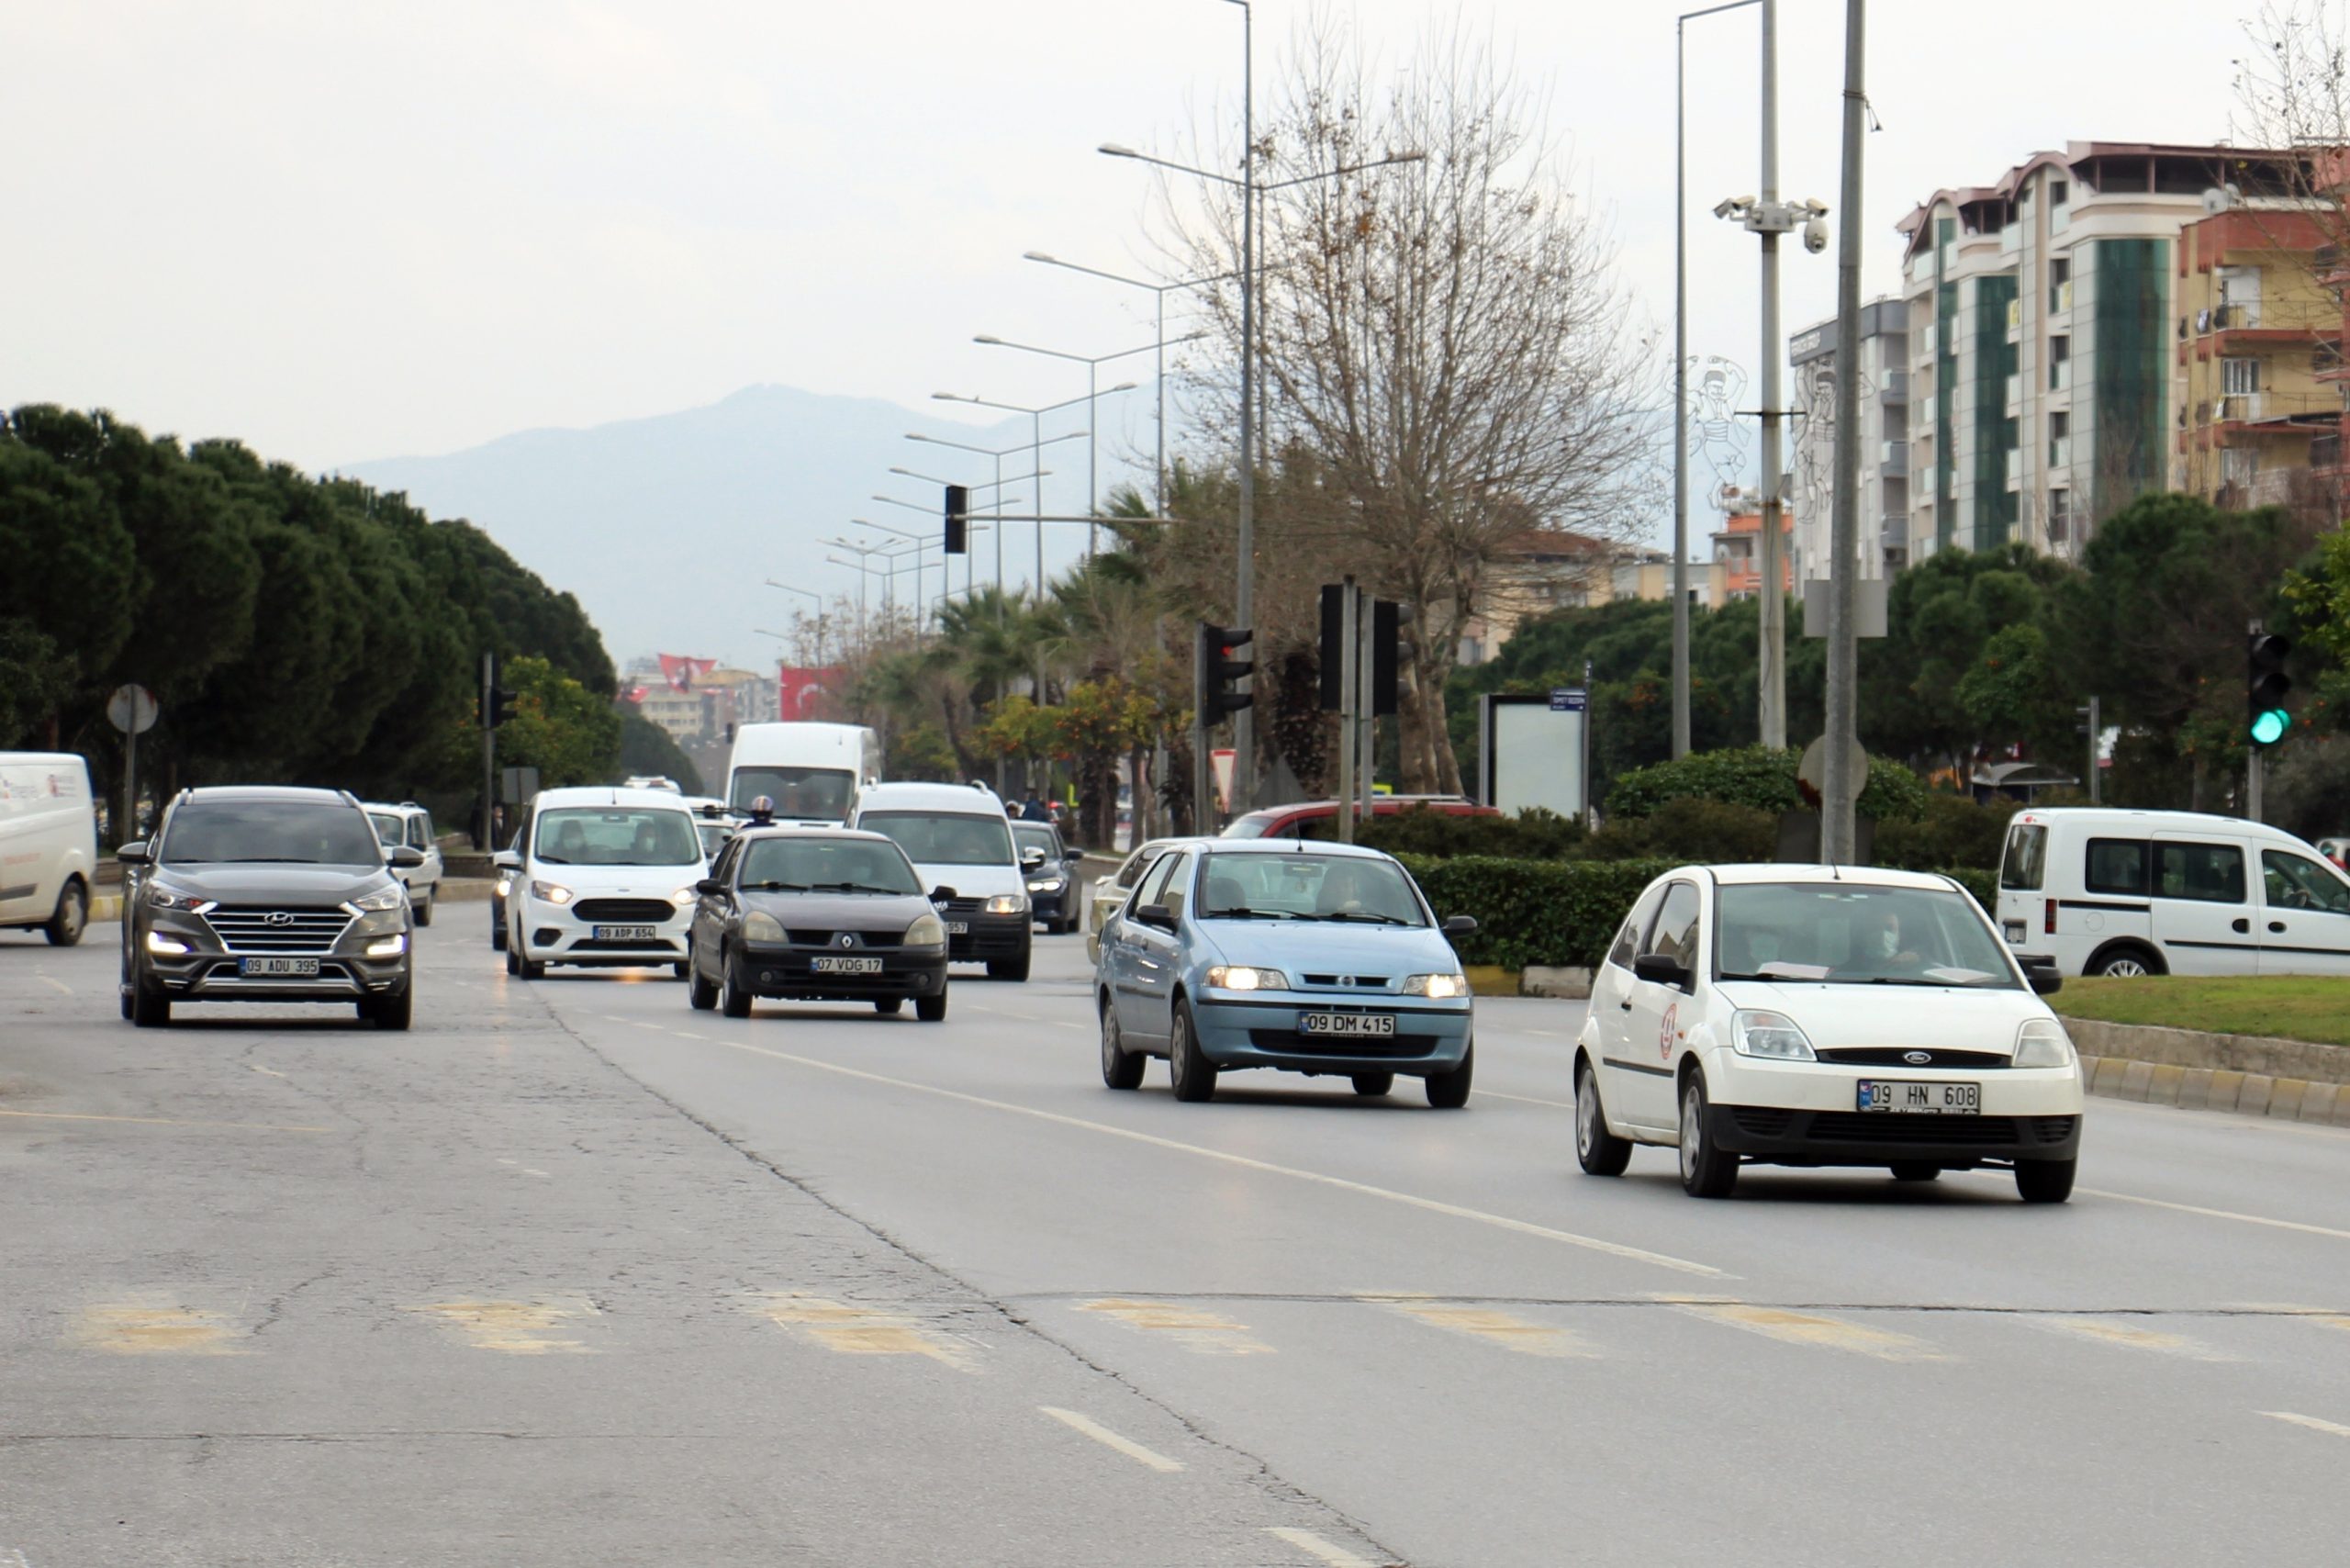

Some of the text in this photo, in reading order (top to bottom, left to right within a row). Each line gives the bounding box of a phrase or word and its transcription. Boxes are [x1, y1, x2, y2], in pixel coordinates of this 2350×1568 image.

[599, 928, 611, 937] 09
[635, 928, 654, 937] 654
[247, 959, 318, 973] 09 ADU 395
[817, 958, 881, 971] 07 VDG 17
[1308, 1014, 1392, 1033] 09 DM 415
[1872, 1085, 1977, 1105] 09 HN 608
